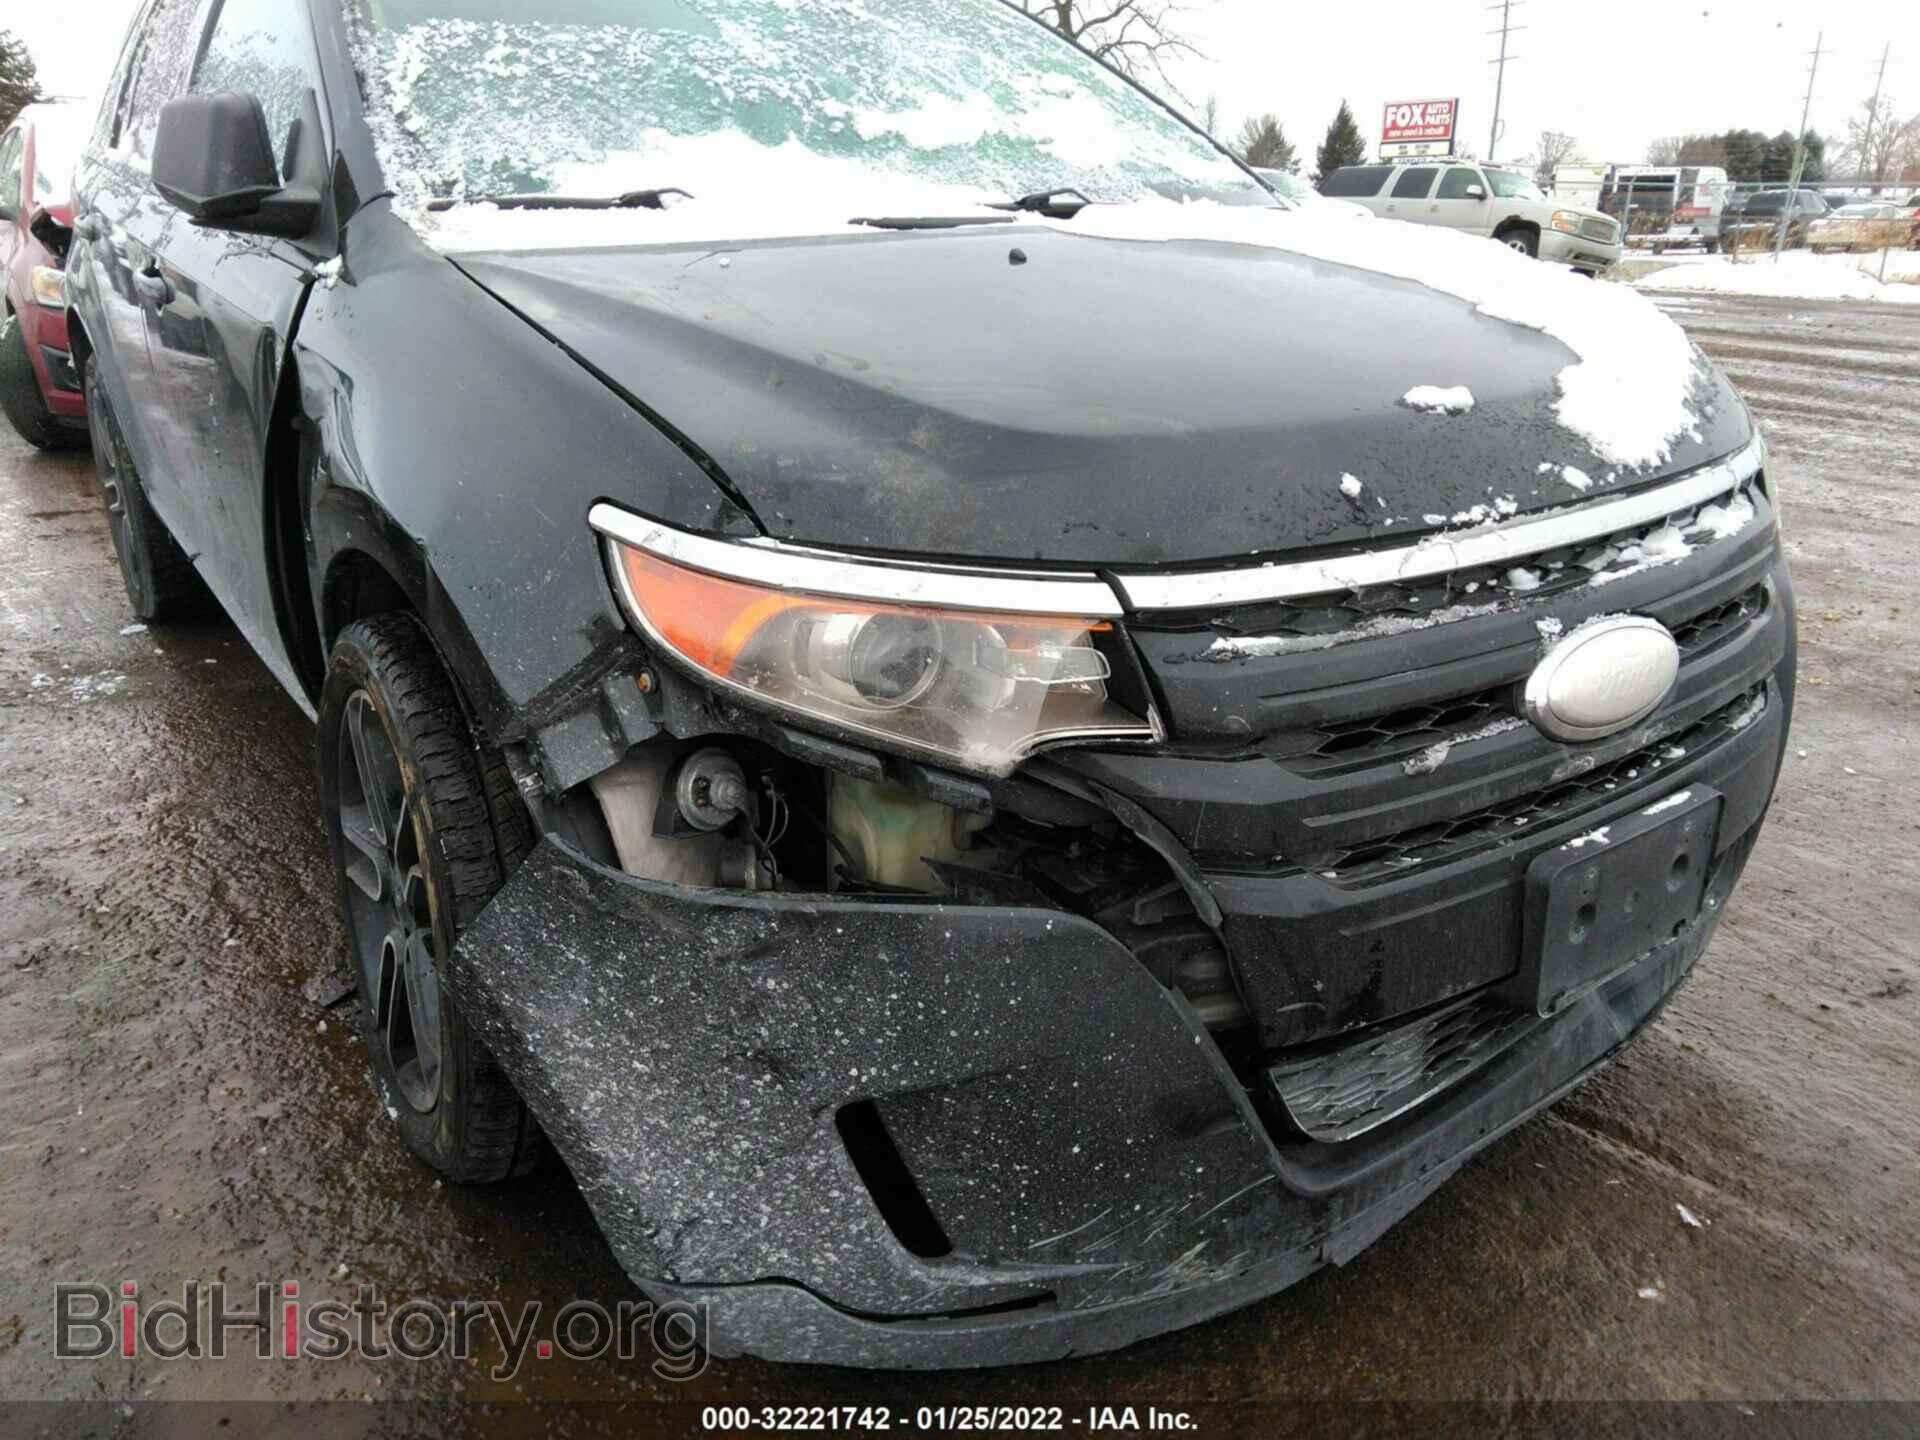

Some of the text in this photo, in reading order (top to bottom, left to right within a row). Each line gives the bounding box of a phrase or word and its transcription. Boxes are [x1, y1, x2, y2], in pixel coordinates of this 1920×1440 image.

[1426, 103, 1449, 114] AUTO
[1386, 104, 1425, 128] FOX
[1425, 113, 1451, 126] PARTS
